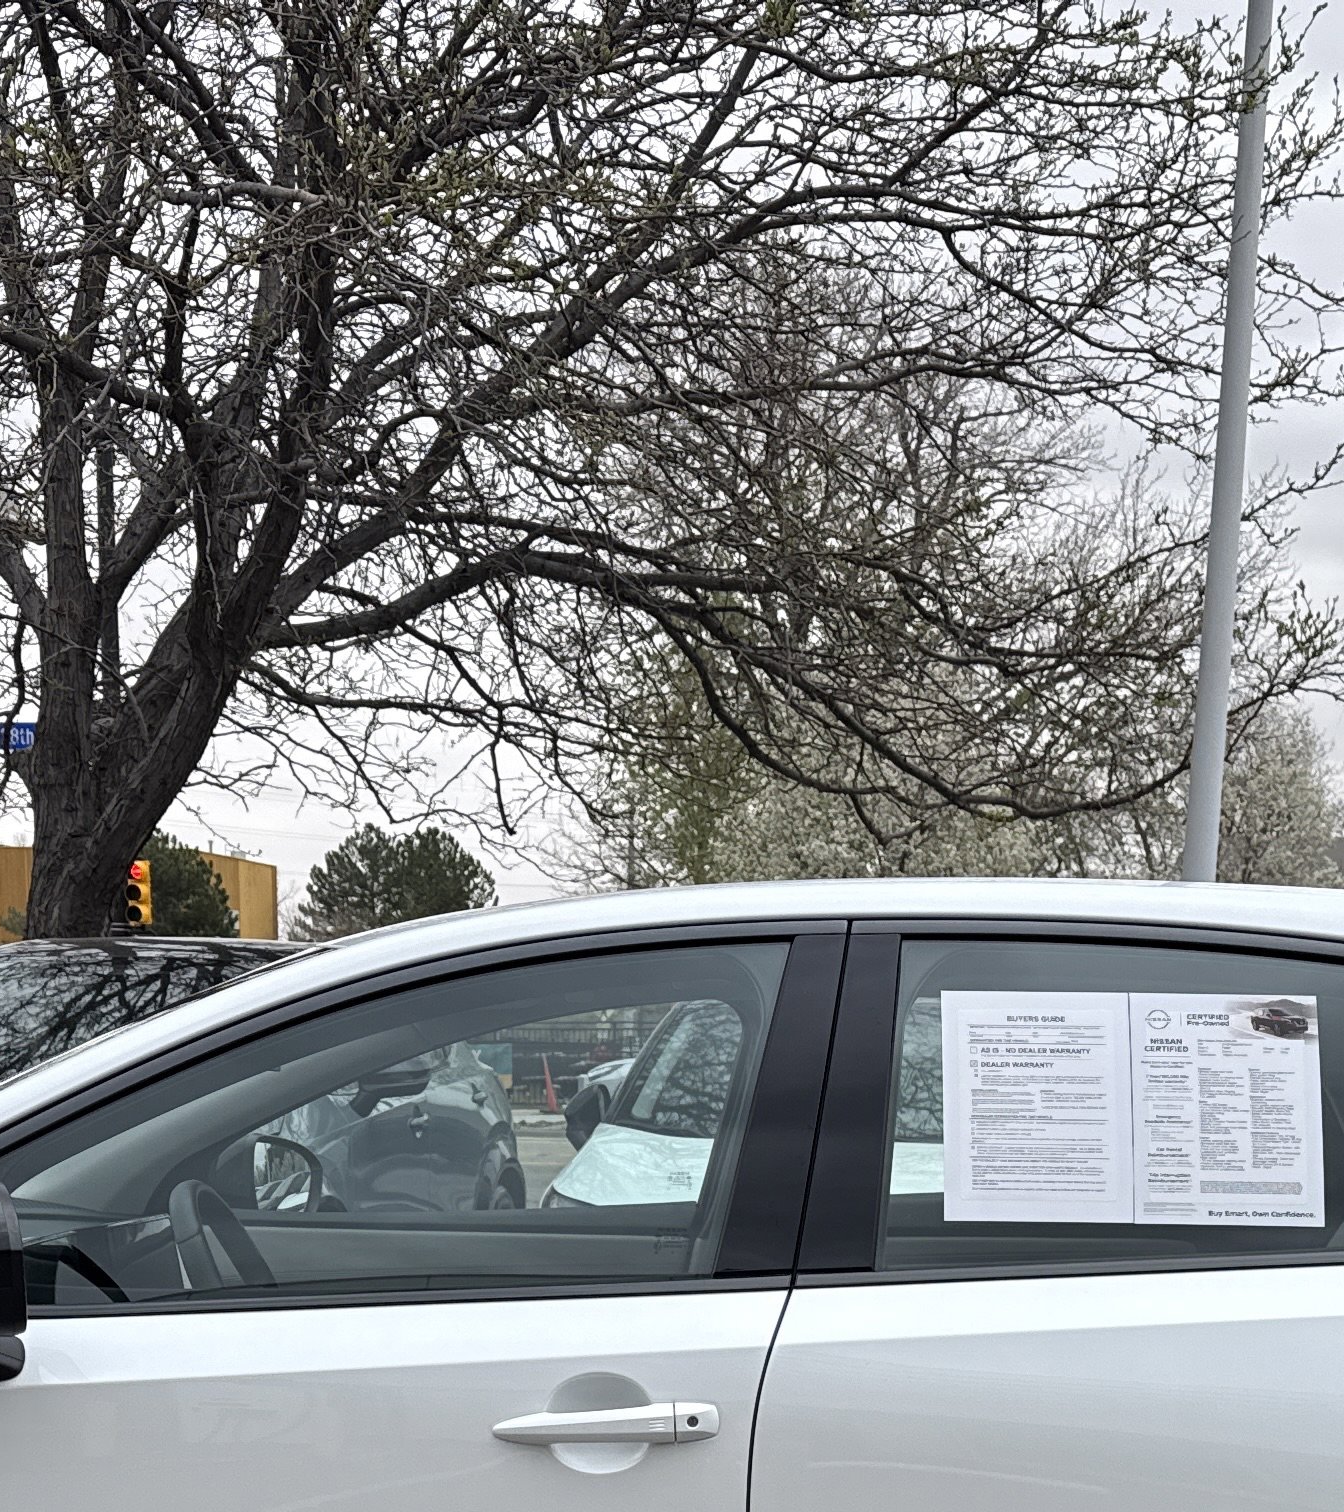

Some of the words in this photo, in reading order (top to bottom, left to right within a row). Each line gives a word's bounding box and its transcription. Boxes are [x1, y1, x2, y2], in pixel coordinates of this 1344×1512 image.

[1040, 1015, 1066, 1023] GUIDE
[1186, 1013, 1230, 1021] CERTIFIED
[1049, 1047, 1091, 1055] WARRANTY
[1144, 1045, 1189, 1053] CERTIFIED
[1208, 1210, 1223, 1218] Buy
[1251, 1210, 1270, 1218] Own
